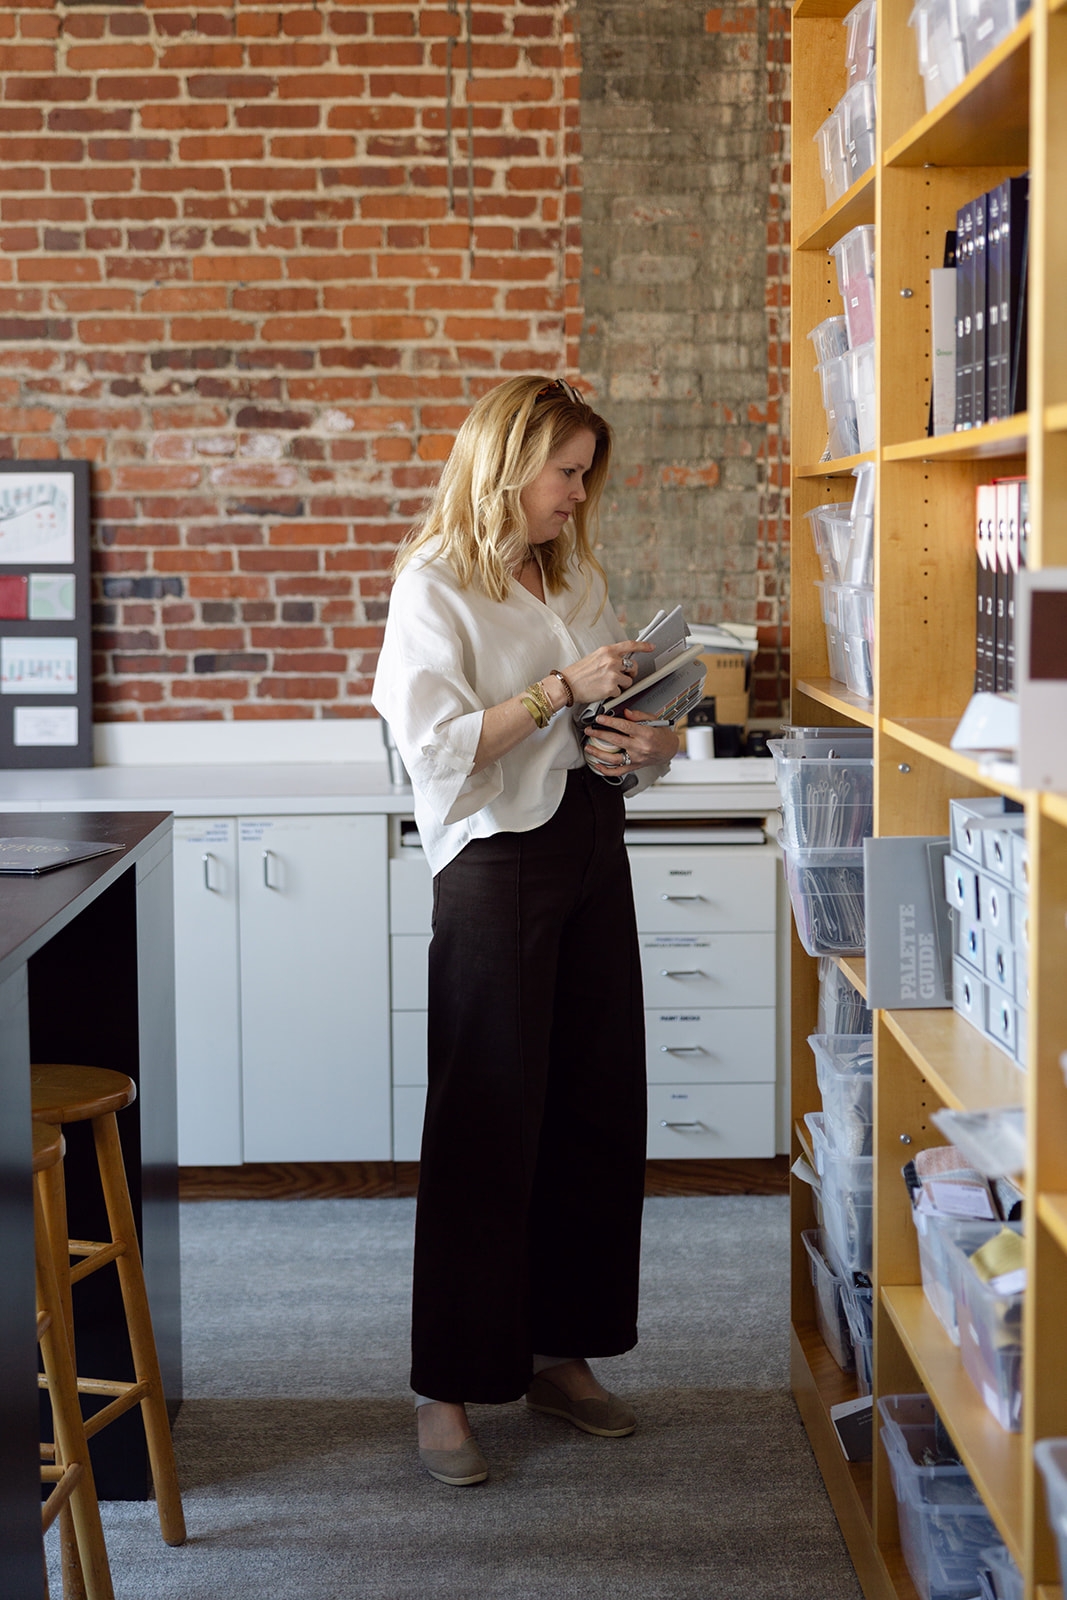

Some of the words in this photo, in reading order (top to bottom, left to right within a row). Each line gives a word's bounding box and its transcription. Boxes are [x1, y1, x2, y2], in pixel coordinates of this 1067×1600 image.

[976, 312, 983, 331] 10
[989, 306, 998, 325] 11
[1001, 302, 1008, 322] 12
[958, 320, 964, 337] 8
[964, 316, 971, 335] 9
[978, 596, 983, 612] 1
[987, 597, 992, 615] 2
[998, 599, 1004, 617] 3
[1008, 600, 1014, 619] 4
[899, 905, 917, 1000] PALETTE
[919, 933, 935, 998] GUIDE
